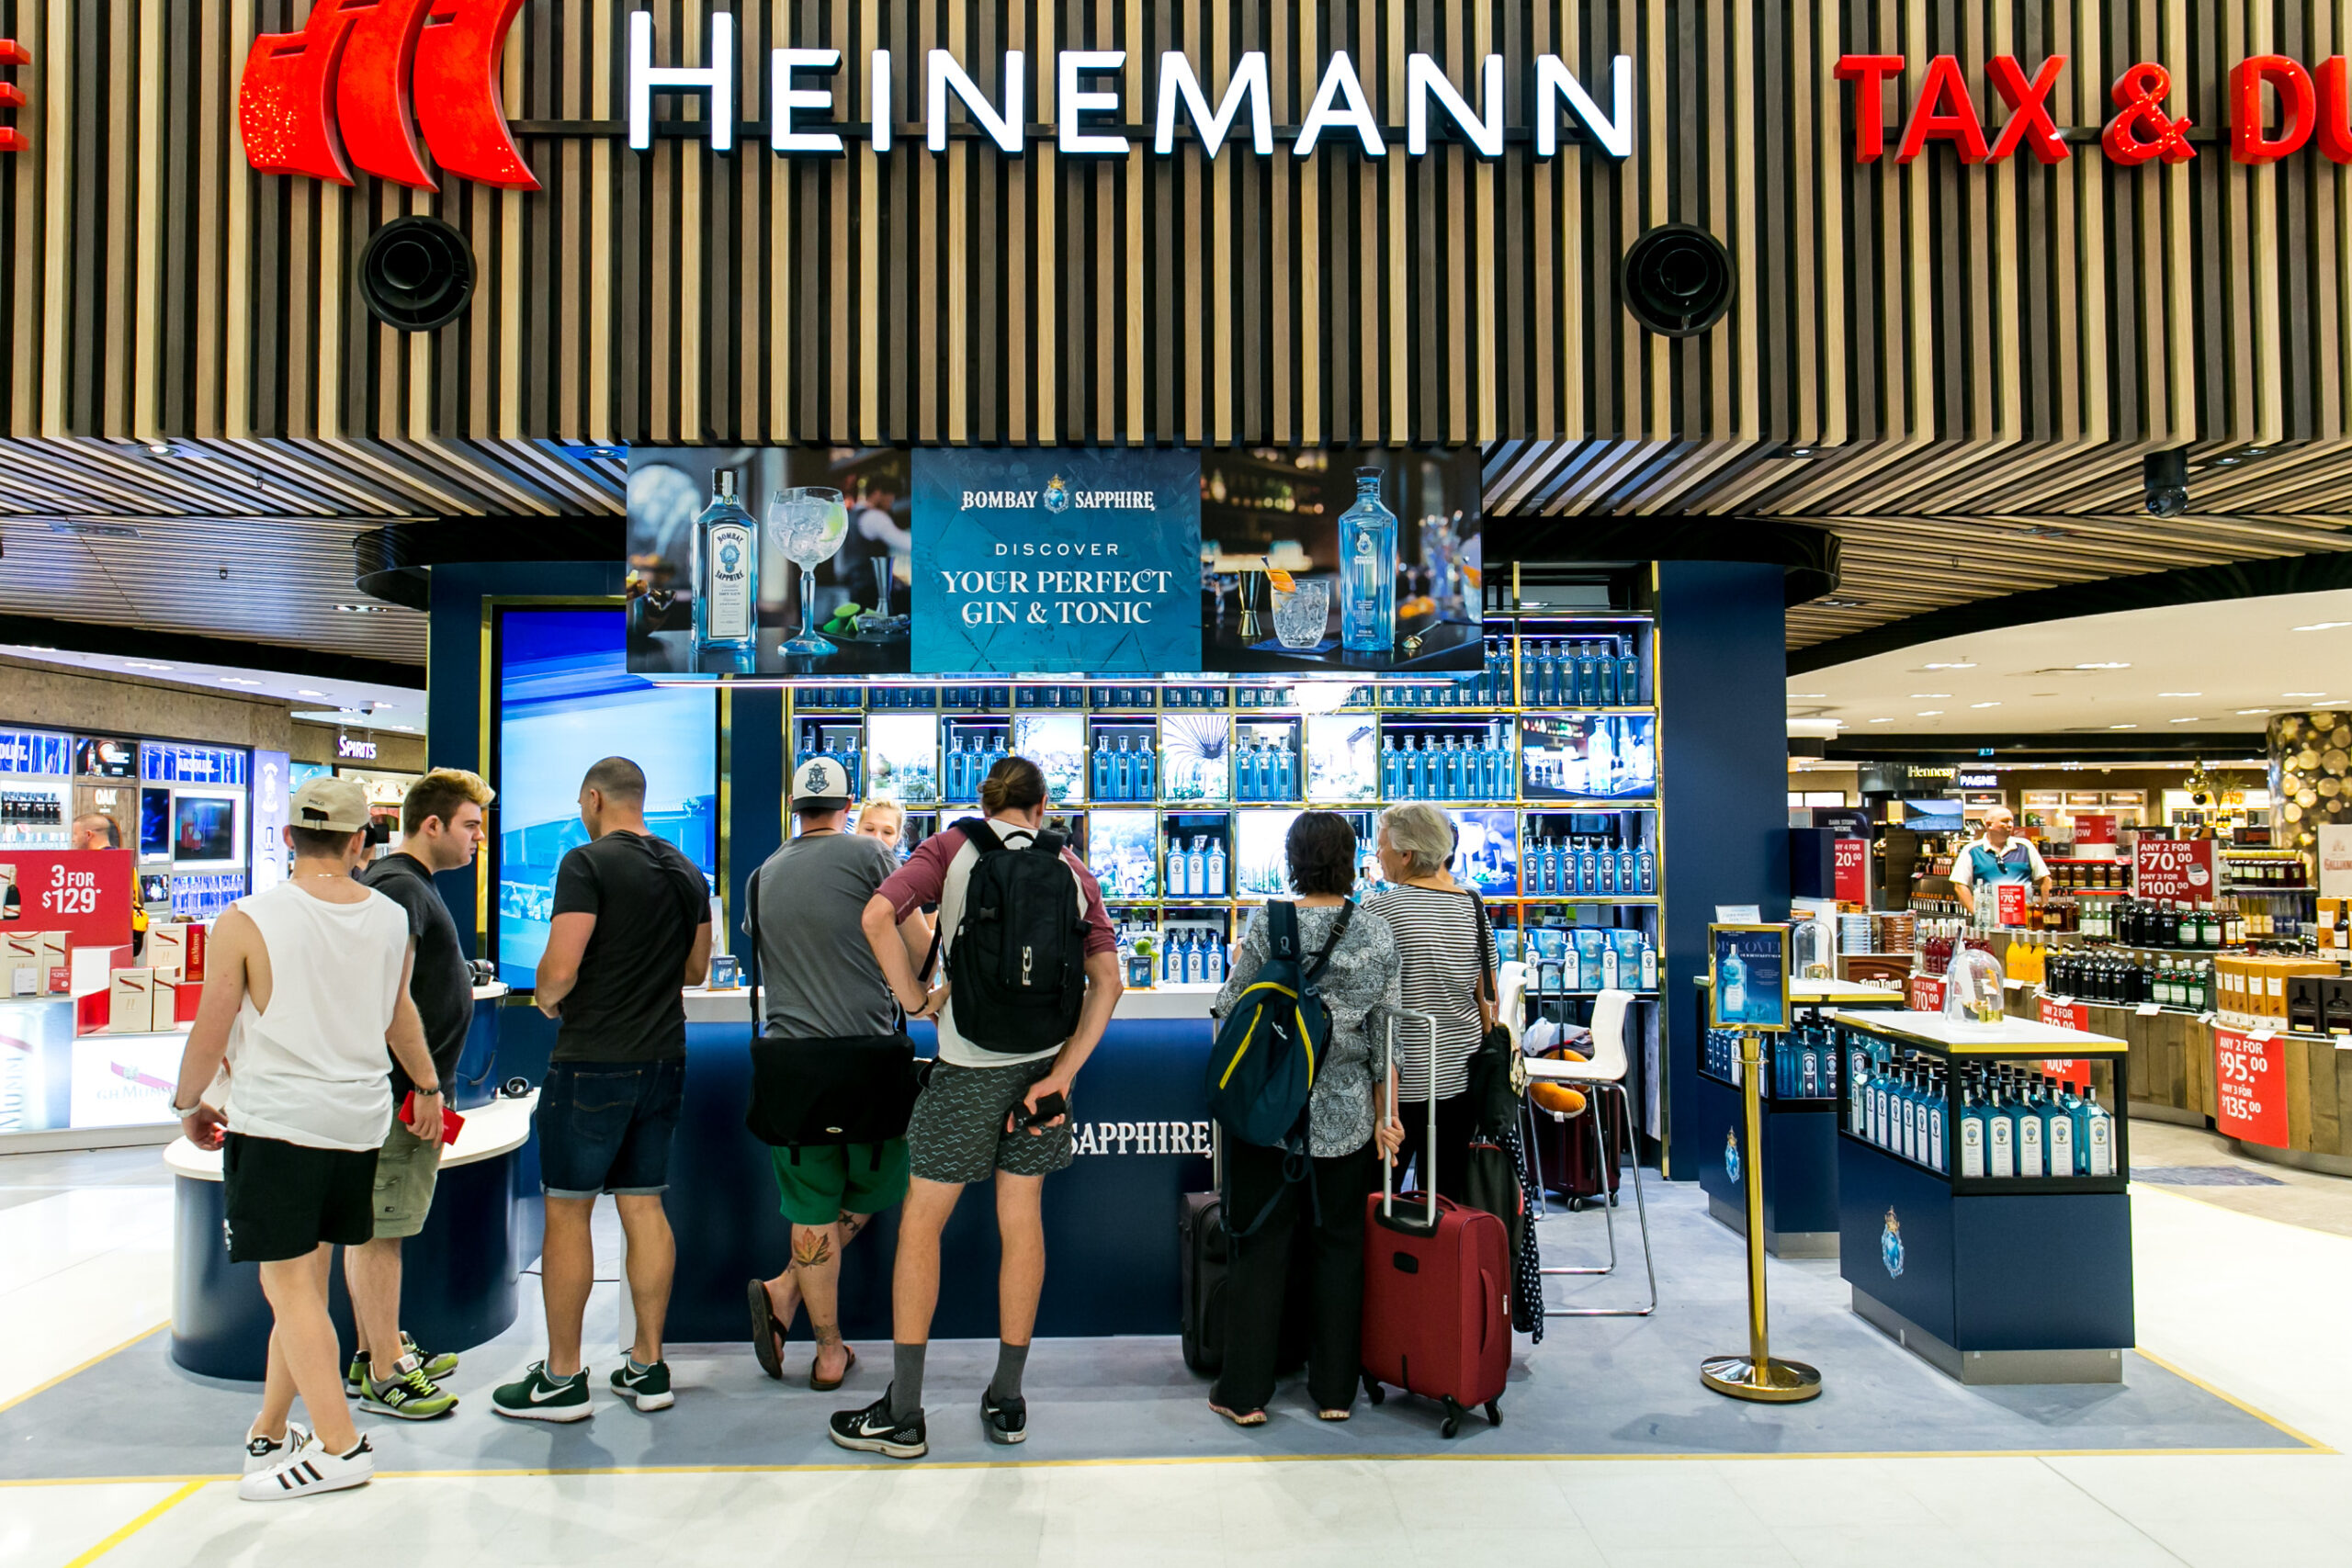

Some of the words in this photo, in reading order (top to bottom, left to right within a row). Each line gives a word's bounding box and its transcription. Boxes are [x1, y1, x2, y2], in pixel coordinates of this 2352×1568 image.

[628, 11, 1633, 158] HEINEMANN
[1834, 55, 2071, 164] TAX
[2102, 62, 2197, 165] &
[961, 491, 1038, 511] BOMBAY
[1075, 491, 1156, 511] SAPPHIRE
[717, 532, 743, 544] BOMBAY
[995, 543, 1119, 556] DISCOVER
[715, 570, 745, 581] SAPPHIRE
[941, 570, 1029, 593] YOUR
[1036, 569, 1172, 593] PERFECT
[961, 602, 1018, 628] GIN
[1026, 602, 1048, 624] &
[1056, 602, 1152, 624] TONIC
[338, 736, 377, 759] SPIRITS
[1907, 765, 1956, 779] Hennessy
[95, 789, 117, 805] OAK
[2140, 843, 2160, 852] ANY
[2163, 843, 2170, 852] 2
[2171, 843, 2191, 852] FOR
[51, 864, 65, 887] 3
[67, 872, 95, 886] FOR
[1022, 945, 1033, 986] FCS
[1926, 982, 1938, 992] FOR
[2052, 1007, 2058, 1017] 2
[2058, 1008, 2074, 1020] FOR
[2220, 1036, 2233, 1050] ANY
[2235, 1039, 2242, 1052] 2
[2243, 1041, 2263, 1055] FOR
[2238, 1087, 2252, 1098] FOR
